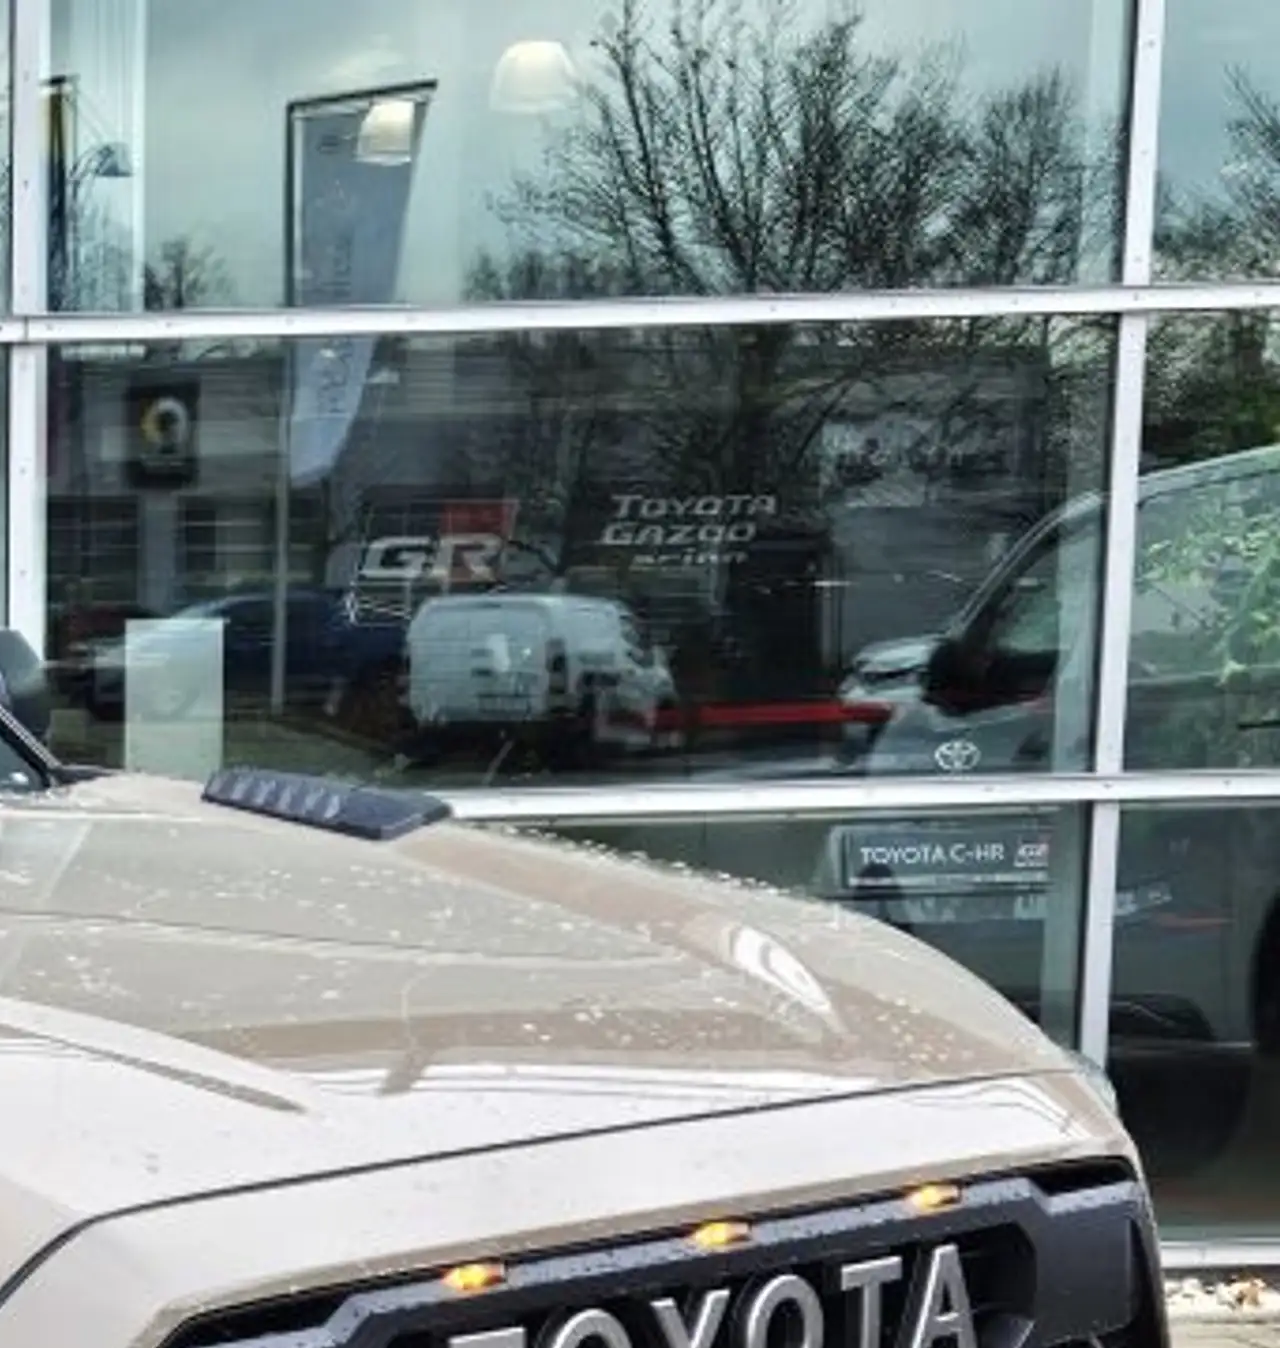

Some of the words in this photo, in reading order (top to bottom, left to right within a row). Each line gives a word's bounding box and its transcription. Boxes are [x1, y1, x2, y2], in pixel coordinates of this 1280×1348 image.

[609, 493, 778, 518] TOYOTA
[360, 532, 504, 583] GR
[860, 844, 946, 866] TOYOTA
[949, 842, 1006, 863] C-HR
